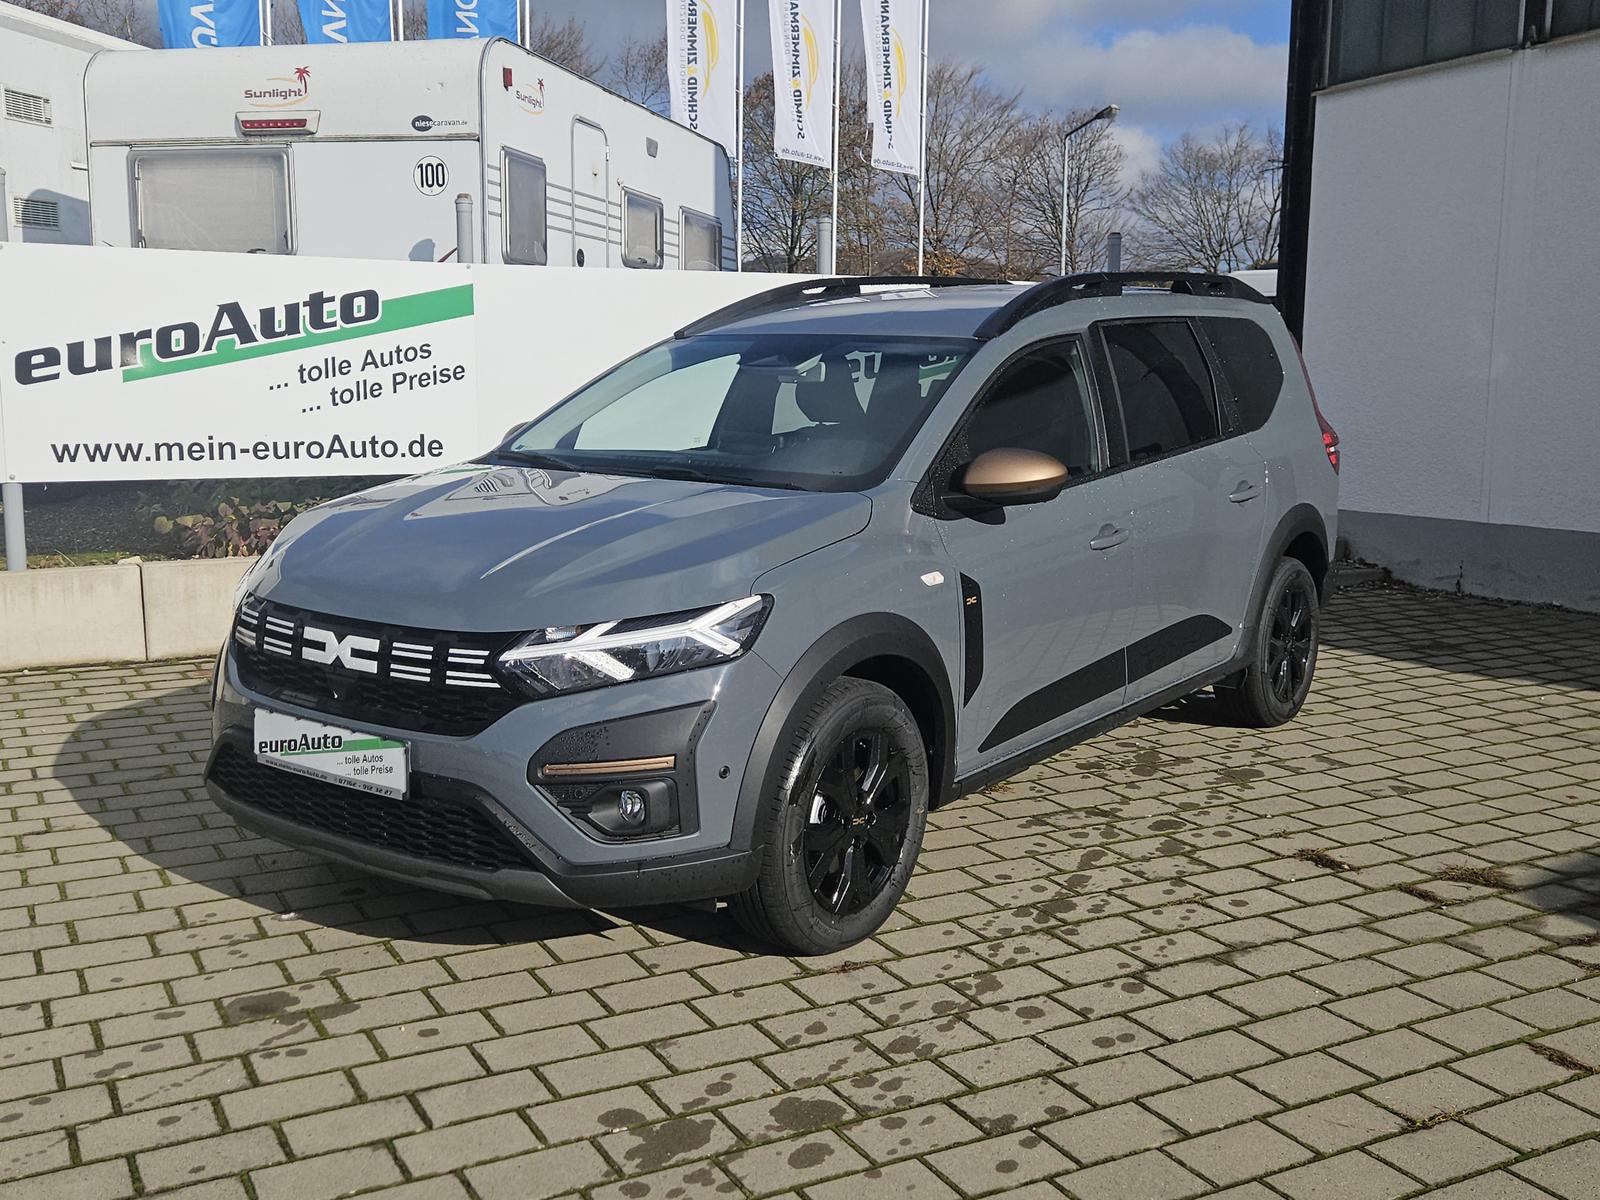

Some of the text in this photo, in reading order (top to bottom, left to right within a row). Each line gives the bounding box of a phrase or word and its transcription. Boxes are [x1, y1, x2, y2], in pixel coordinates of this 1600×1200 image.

[244, 87, 303, 100] Sunlight
[516, 90, 544, 109] Sunlight
[417, 162, 446, 188] 100
[14, 288, 380, 386] euroAuto
[298, 356, 352, 385] tolle
[360, 342, 433, 372] Autos
[330, 379, 383, 407] tolle
[392, 364, 466, 394] Preise
[50, 433, 444, 464] www.mein-euroAuto.de
[258, 733, 343, 754] euroAuto
[345, 756, 361, 764] tolle
[362, 754, 384, 764] Autos
[353, 766, 369, 776] tolle
[371, 764, 394, 775] Preise
